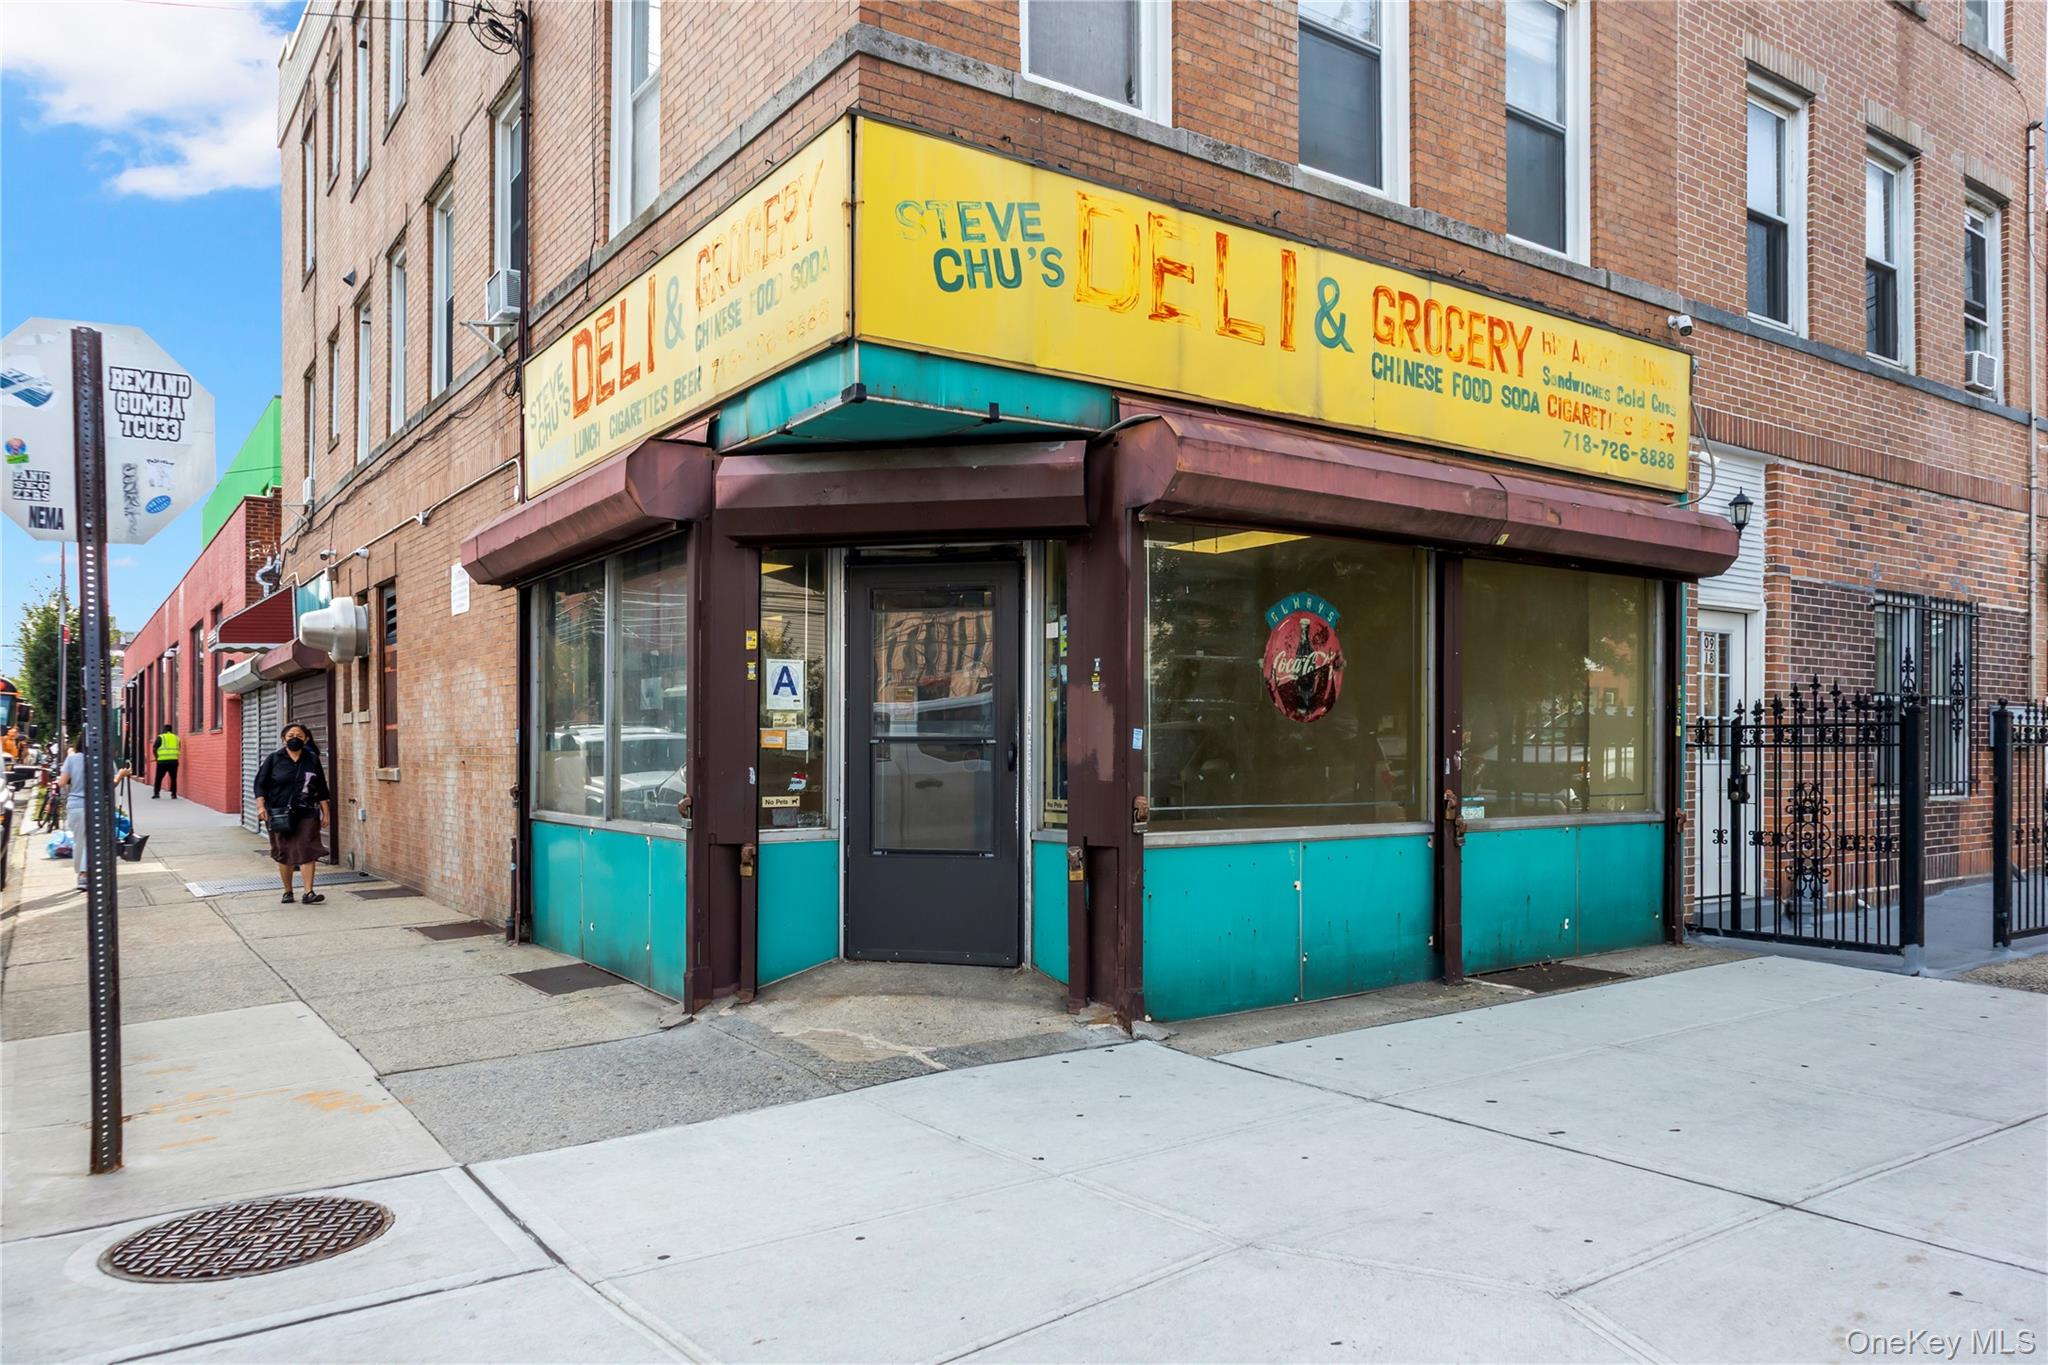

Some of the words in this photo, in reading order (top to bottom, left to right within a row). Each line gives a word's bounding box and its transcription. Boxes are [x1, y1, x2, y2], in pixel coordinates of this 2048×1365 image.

[895, 199, 1046, 244] STEVE
[572, 274, 657, 420] DELI
[664, 275, 686, 350] &
[695, 159, 825, 312] GROCERY
[933, 246, 1066, 293] CHU'S
[1074, 190, 1298, 353] DELI
[1314, 276, 1355, 354] &
[1372, 284, 1534, 378] GROCERY
[694, 297, 743, 353] CHINESE
[790, 245, 831, 294] SODA
[109, 366, 192, 399] REMAND
[115, 390, 185, 421] GUMBA
[530, 361, 565, 431] STEVE
[1371, 352, 1444, 394] CHINESE
[1452, 371, 1493, 405] FOOD
[1500, 384, 1541, 415] SODA
[538, 385, 571, 450] CHU'S
[574, 420, 602, 459] LUNCH
[609, 384, 669, 440] CIGARETTES
[673, 365, 703, 406] BEER
[1562, 429, 1676, 471] 718-726-8888
[28, 505, 64, 530] NEMA
[1270, 597, 1335, 623] ALWAYS
[773, 665, 798, 696] A
[775, 798, 789, 806] Pets
